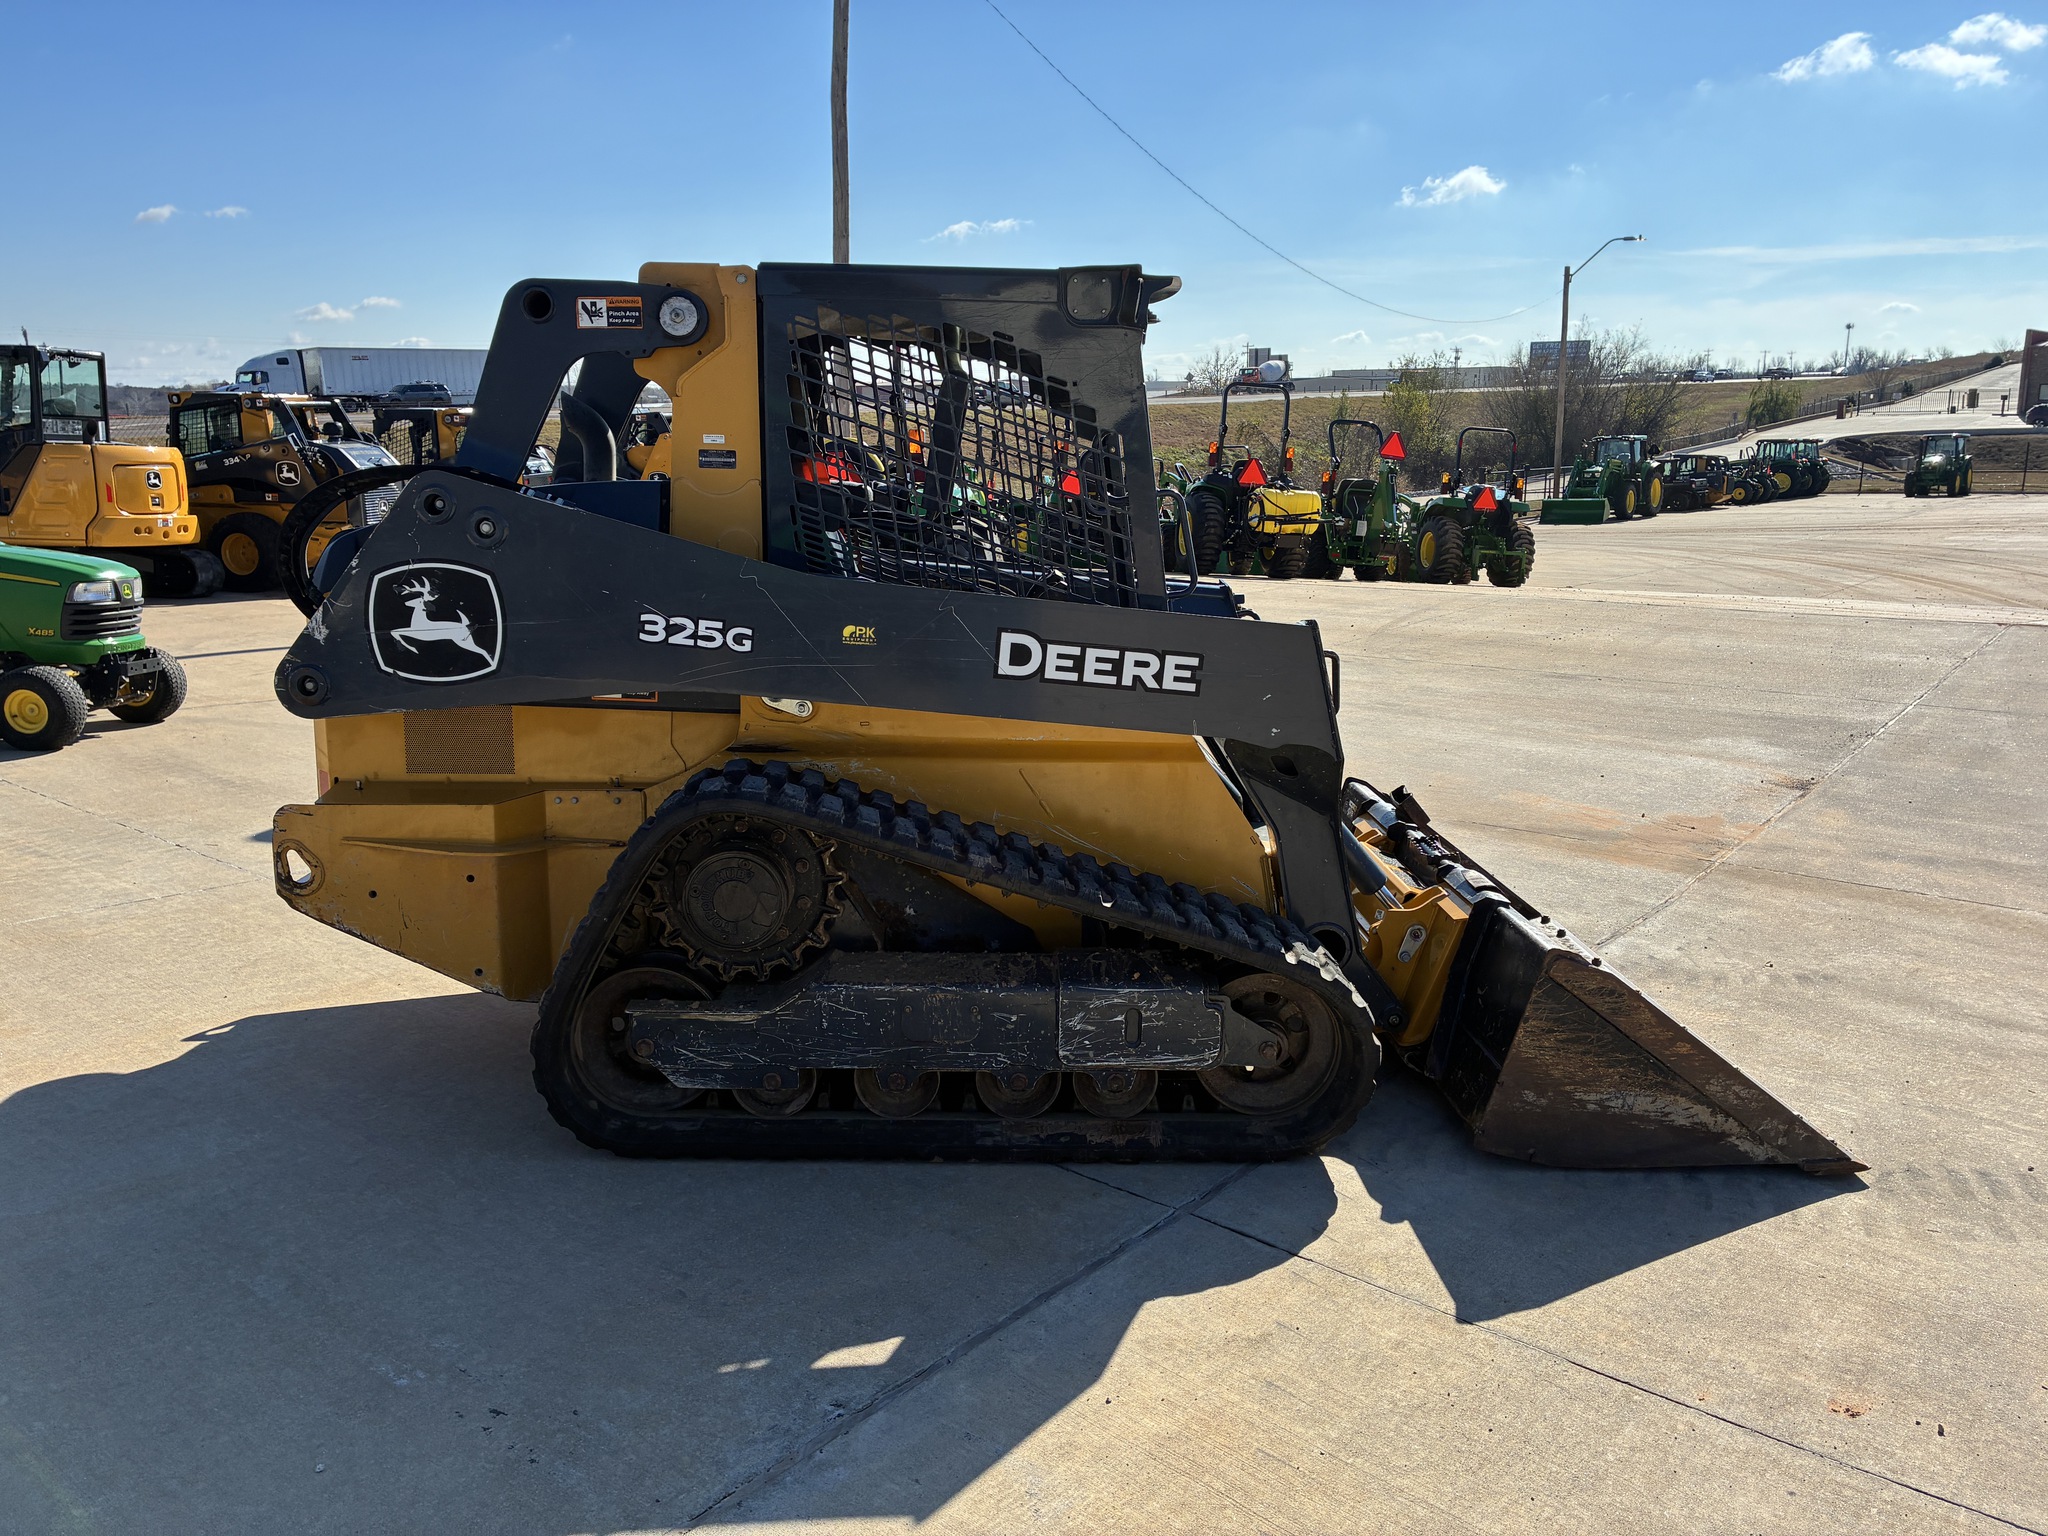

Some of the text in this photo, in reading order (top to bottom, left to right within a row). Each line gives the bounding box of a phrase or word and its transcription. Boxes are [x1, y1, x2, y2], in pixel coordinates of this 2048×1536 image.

[222, 456, 241, 466] 334
[28, 627, 55, 636] X485
[639, 613, 753, 652] 325G
[998, 632, 1200, 692] DEERE
